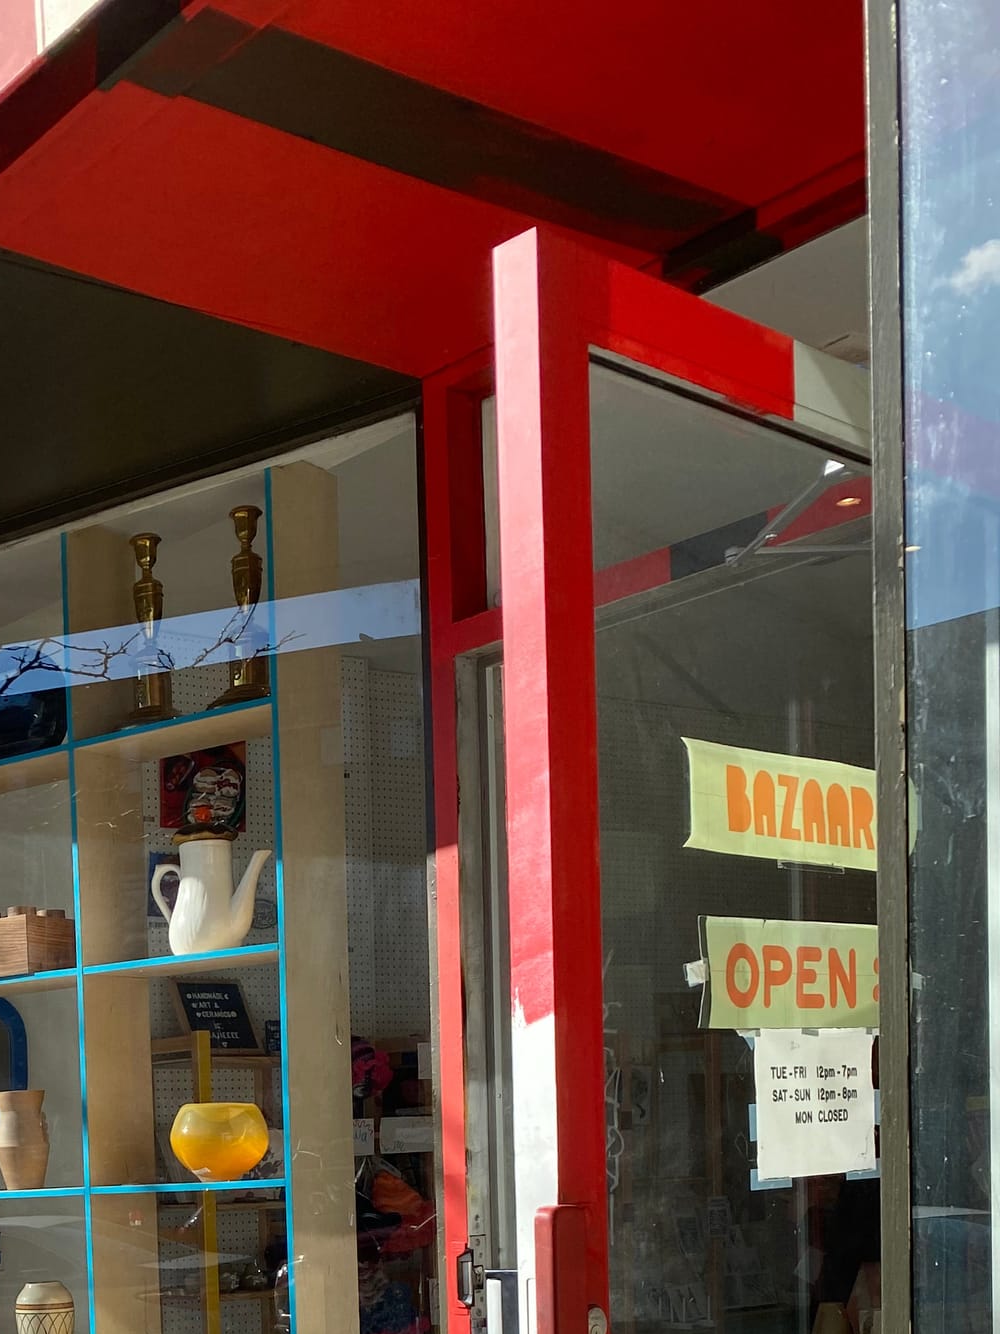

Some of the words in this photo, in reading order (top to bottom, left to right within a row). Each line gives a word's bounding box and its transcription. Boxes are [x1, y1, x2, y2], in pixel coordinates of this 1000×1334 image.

[726, 764, 876, 850] BAZAAR
[725, 943, 857, 1009] OPEN
[795, 1111, 813, 1124] MON
[818, 1108, 849, 1122] CLOSED
